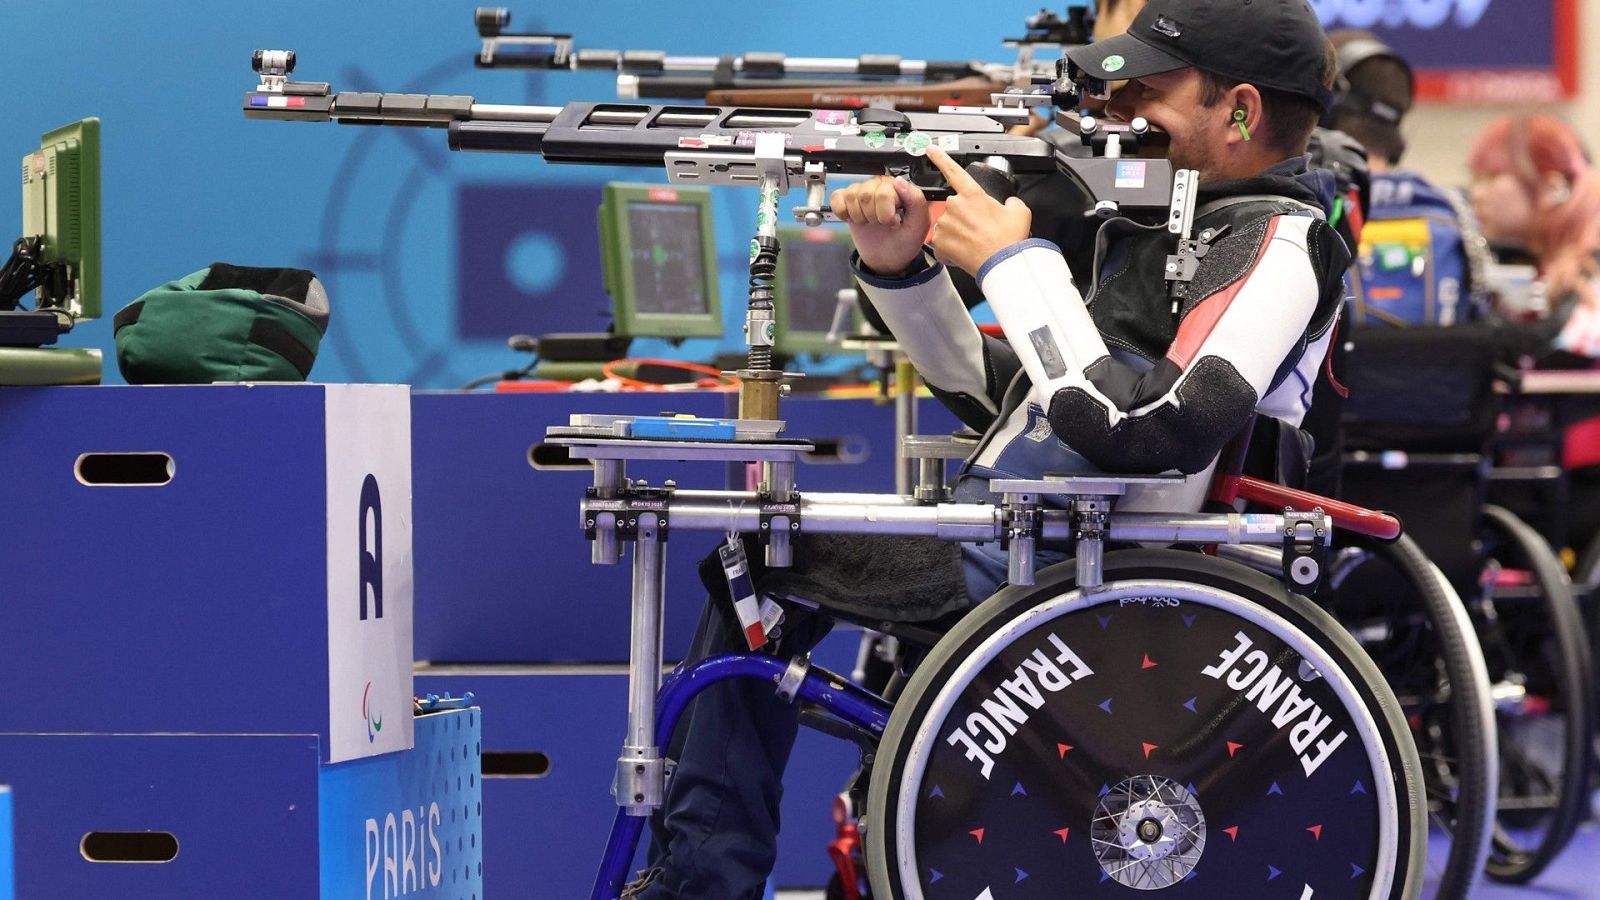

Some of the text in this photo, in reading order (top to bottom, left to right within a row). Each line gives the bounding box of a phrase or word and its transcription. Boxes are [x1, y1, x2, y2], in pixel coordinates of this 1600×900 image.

[359, 473, 383, 620] A
[946, 632, 1095, 780] FRANCE
[1201, 630, 1349, 778] FRANCE
